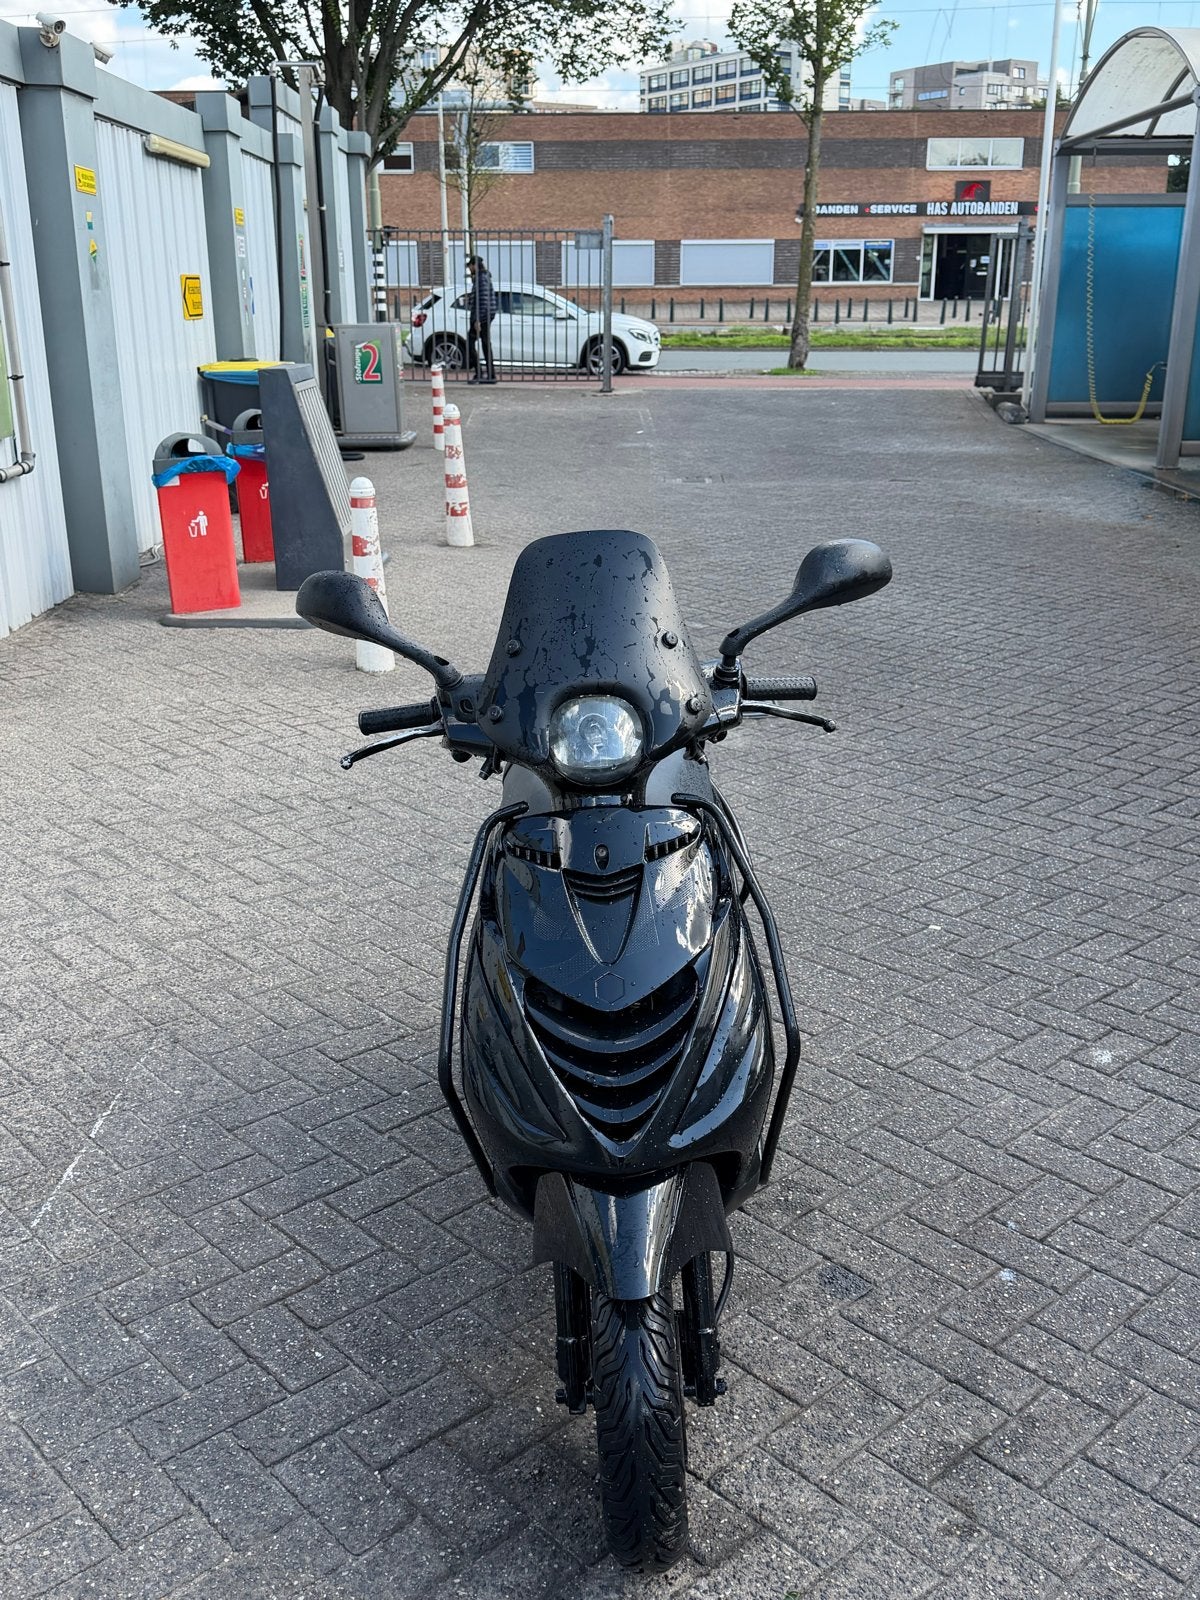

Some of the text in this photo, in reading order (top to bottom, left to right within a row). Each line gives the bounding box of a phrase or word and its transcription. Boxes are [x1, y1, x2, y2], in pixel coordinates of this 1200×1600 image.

[870, 204, 917, 214] SERVICE
[926, 201, 1018, 215] HAS AUTOBANDEN
[362, 343, 381, 381] 2
